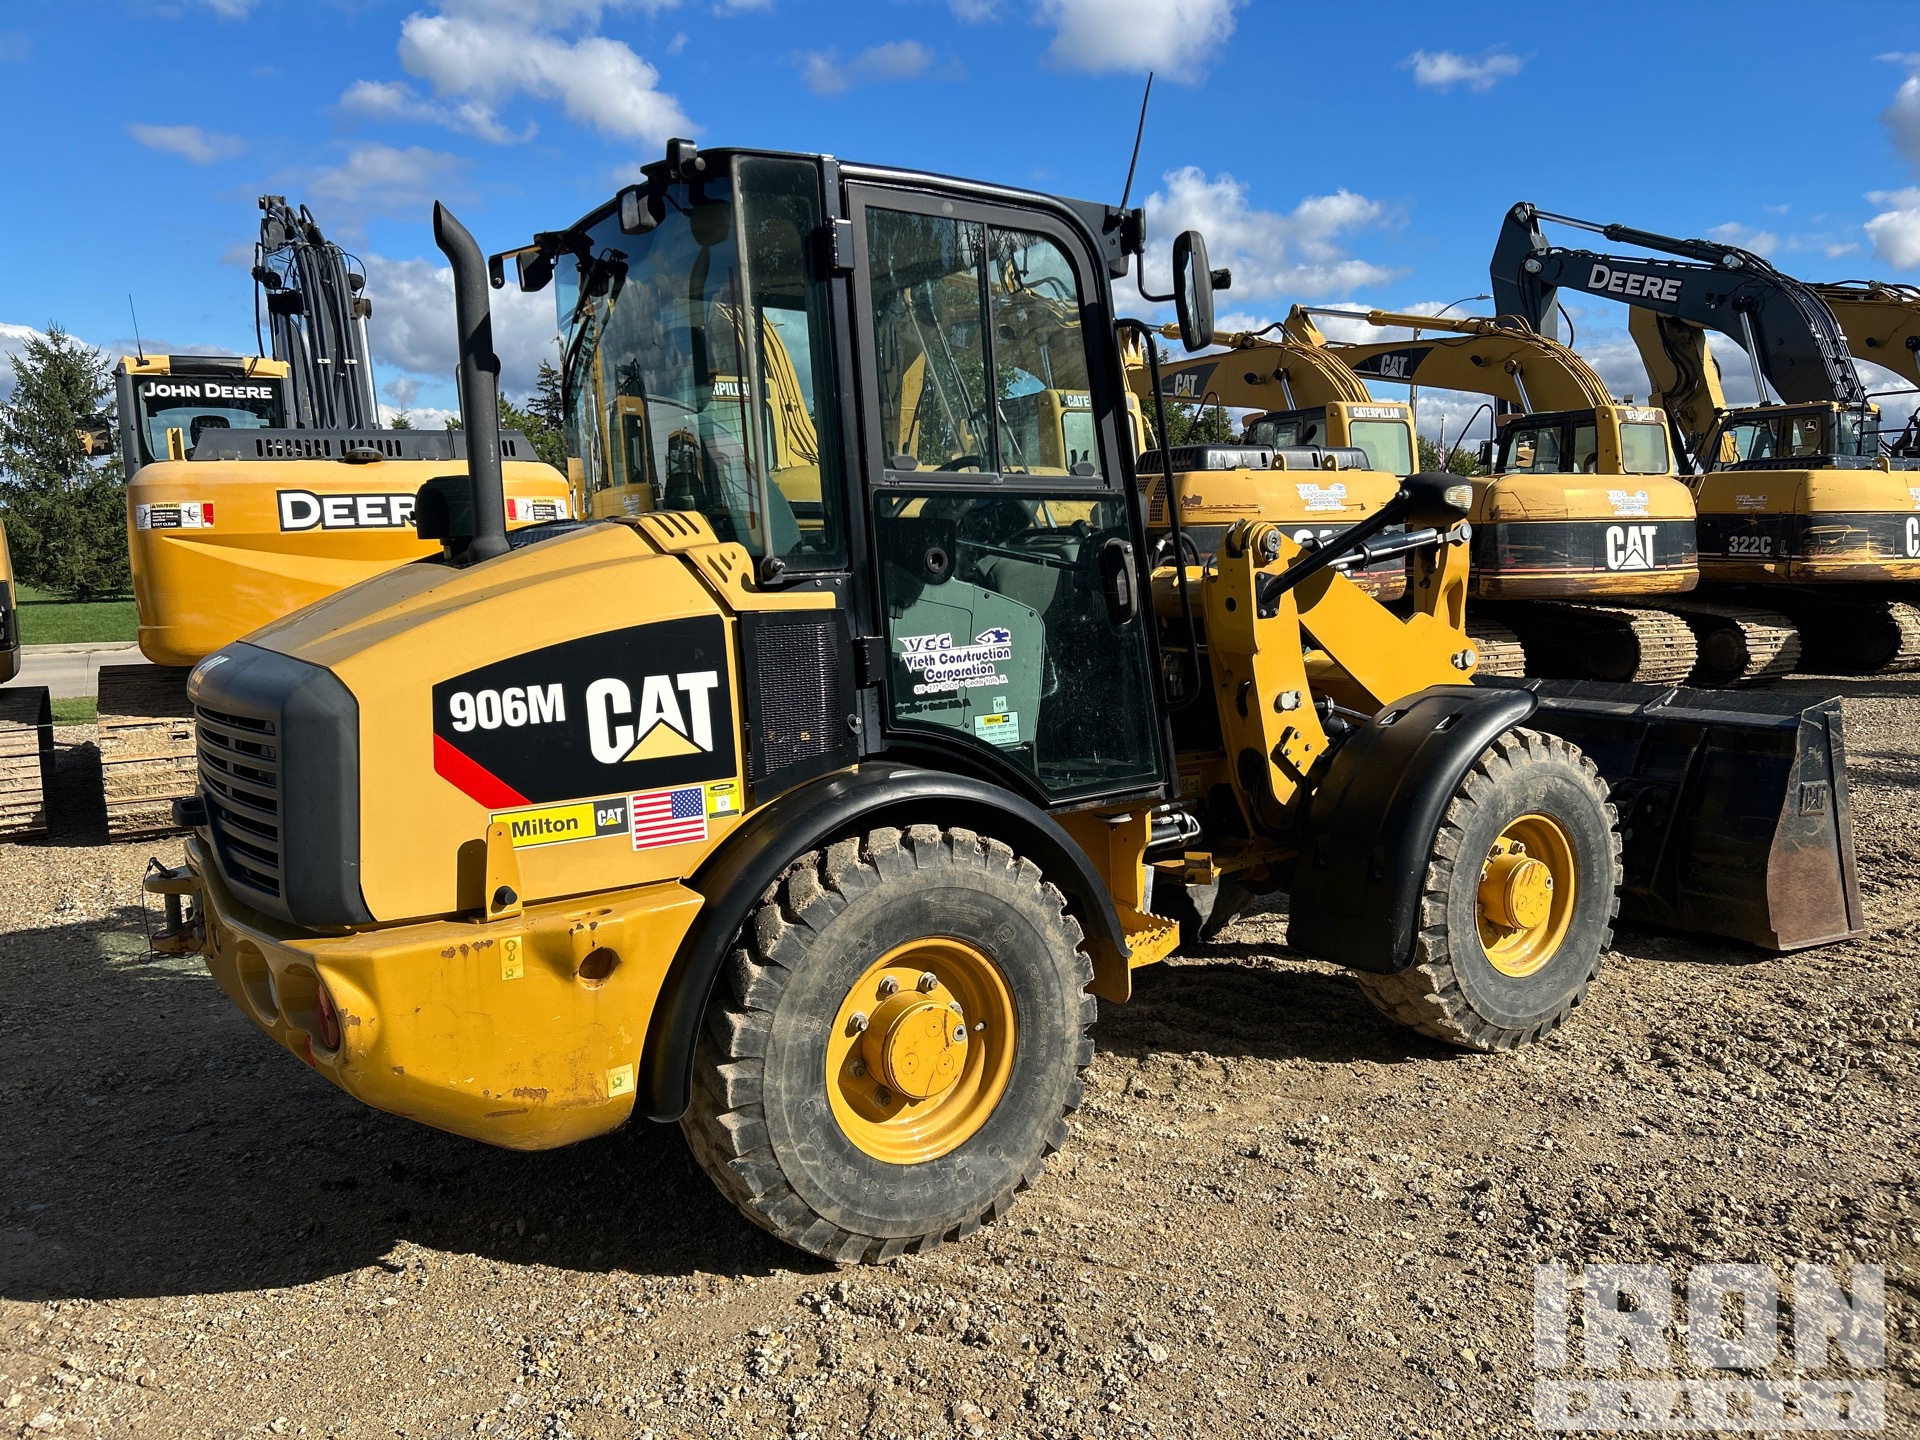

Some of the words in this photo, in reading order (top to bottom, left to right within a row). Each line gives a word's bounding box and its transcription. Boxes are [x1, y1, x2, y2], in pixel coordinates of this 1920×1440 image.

[1588, 264, 1682, 301] DEERE
[1381, 355, 1407, 378] CAT
[145, 382, 200, 398] JOHN
[205, 383, 272, 399] DEERE
[1174, 373, 1198, 397] CAT
[1353, 407, 1400, 419] CATERPILLAR
[280, 493, 417, 529] DEER
[1606, 525, 1657, 571] CAT
[1729, 536, 1772, 554] 322C
[903, 636, 950, 652] VCC
[906, 654, 936, 669] Vieth
[939, 649, 1010, 665] Construction
[925, 663, 994, 681] Corporation
[965, 678, 984, 687] Cedar
[450, 683, 566, 732] 906M
[585, 670, 719, 764] CAT
[1805, 787, 1827, 811] CAT
[512, 815, 579, 838] Milton
[596, 807, 623, 827] CAT
